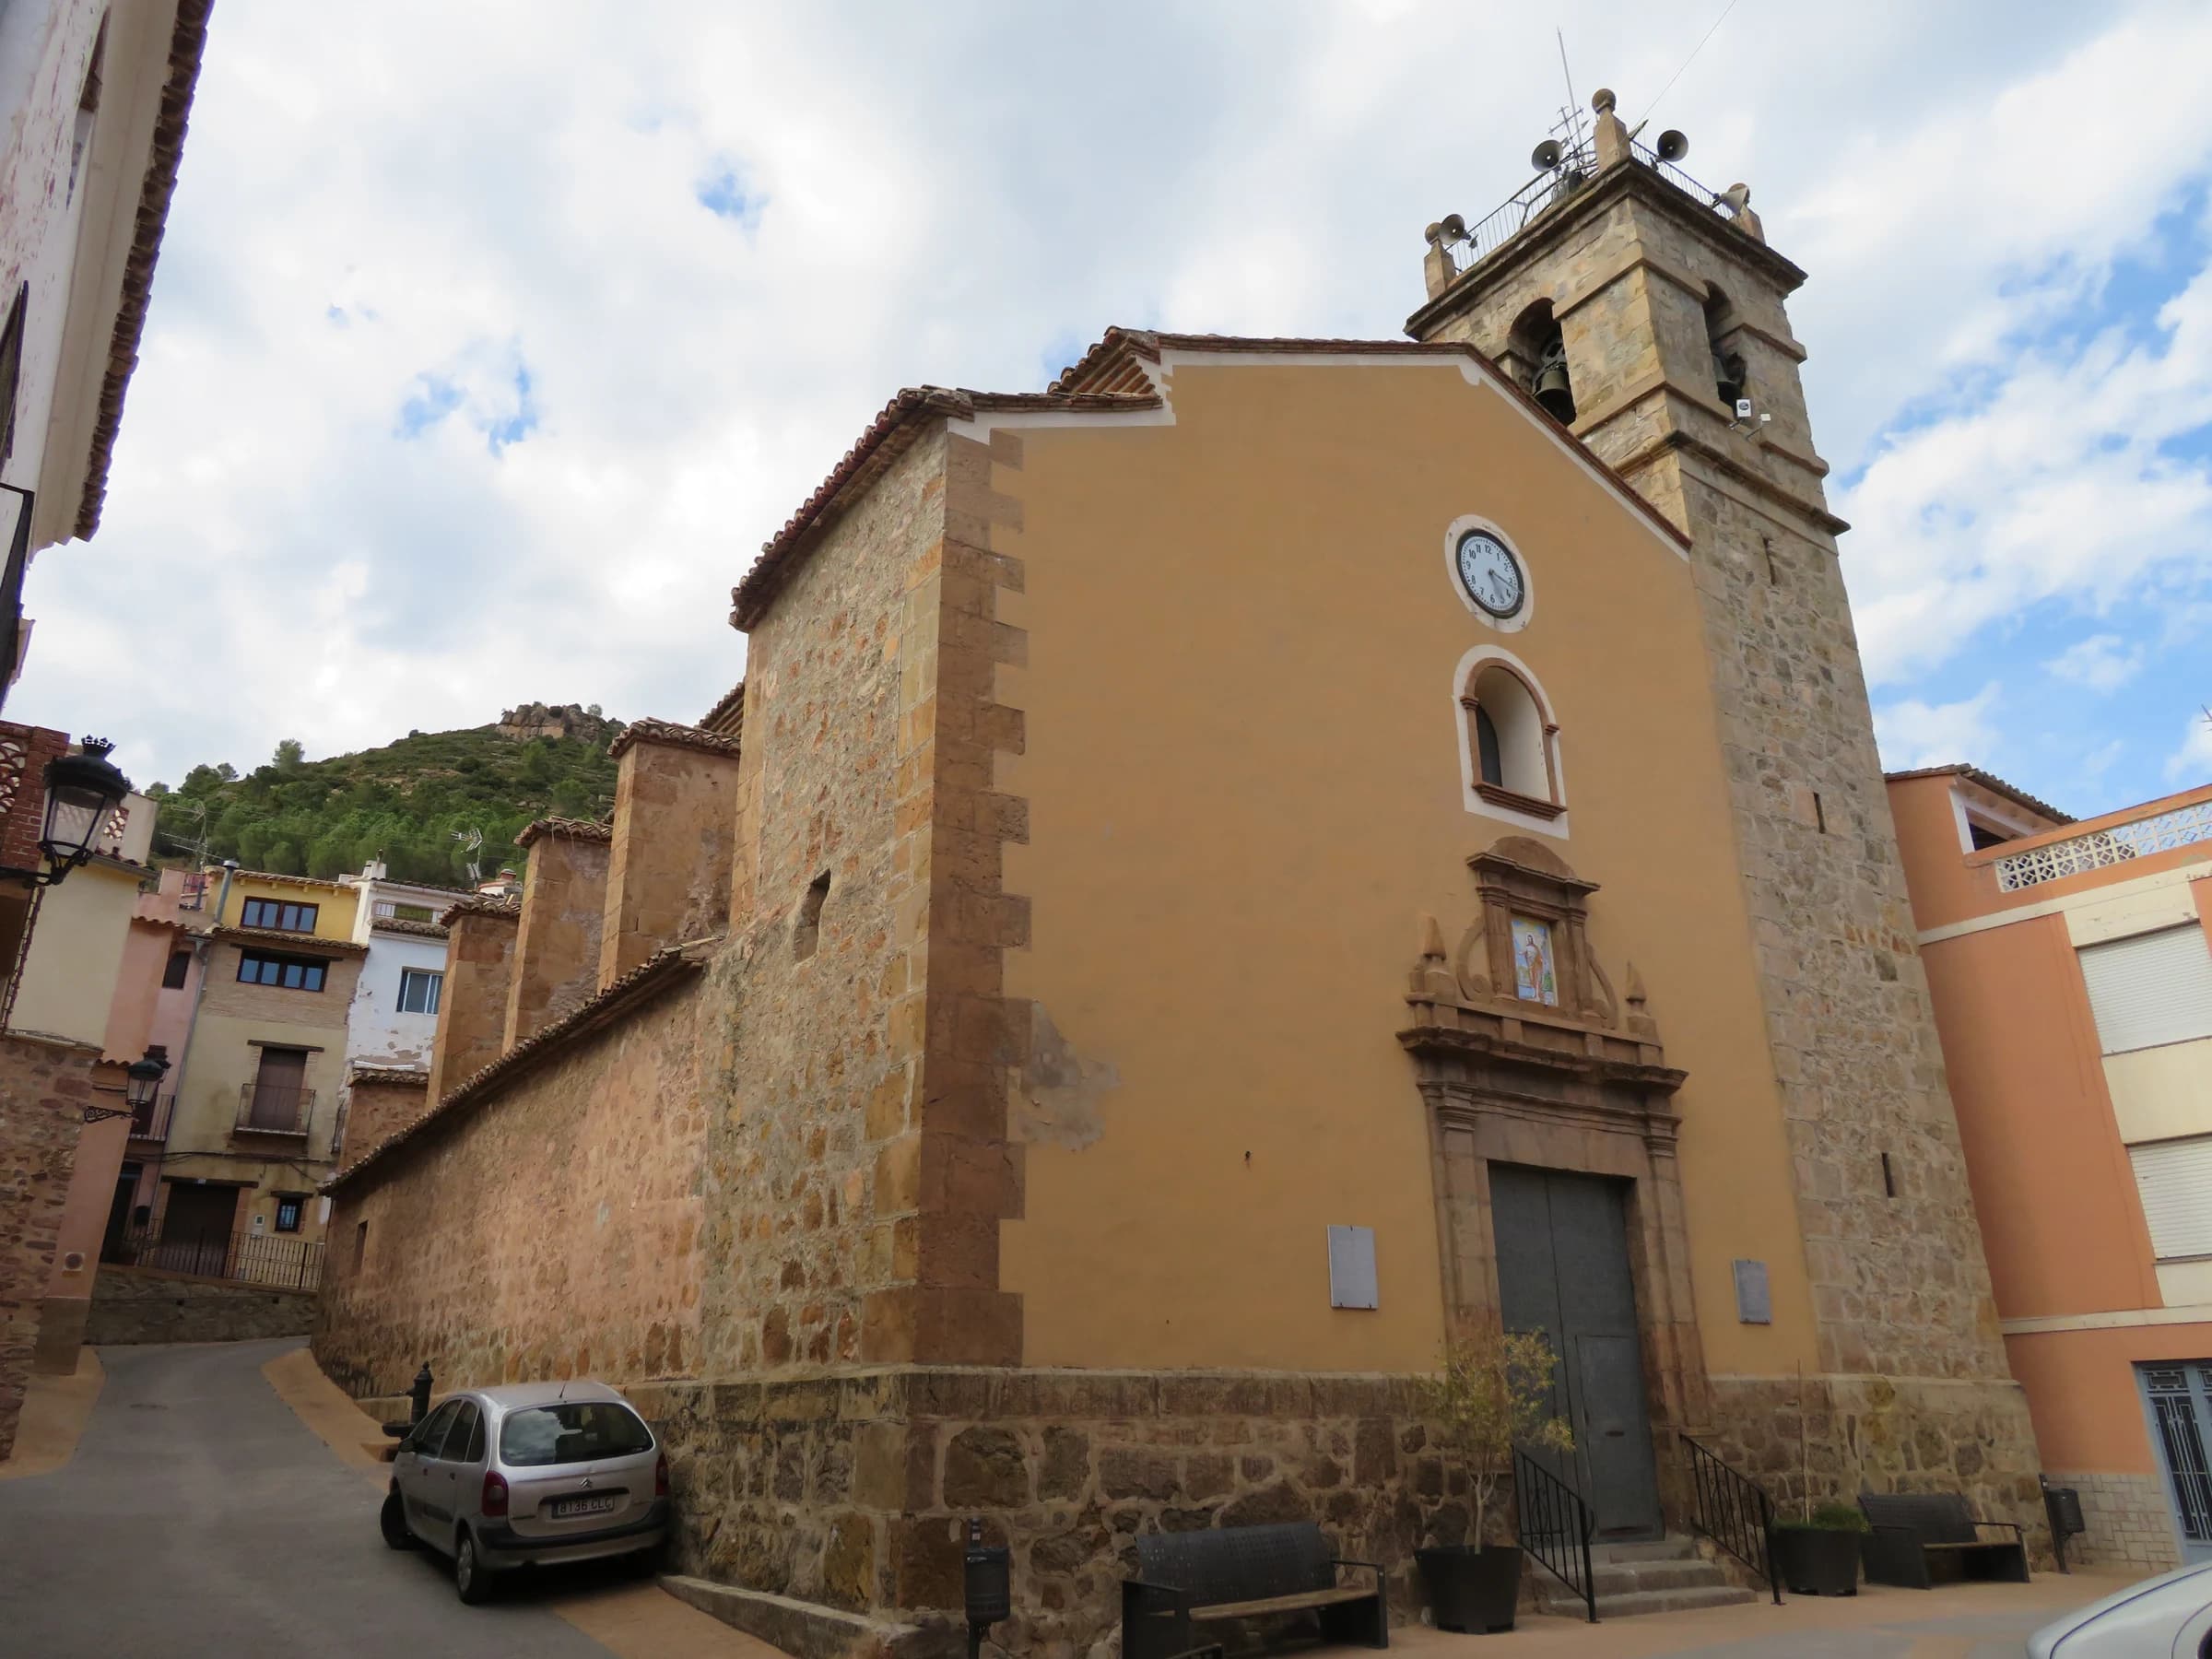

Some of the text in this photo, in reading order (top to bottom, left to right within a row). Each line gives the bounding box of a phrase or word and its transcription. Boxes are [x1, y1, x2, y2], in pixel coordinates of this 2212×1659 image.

[1476, 544, 1481, 553] 11
[1485, 544, 1491, 554] 12
[1469, 549, 1477, 559] 10
[1466, 560, 1471, 570] 9
[1471, 575, 1476, 584] 8
[1490, 594, 1495, 603] 6
